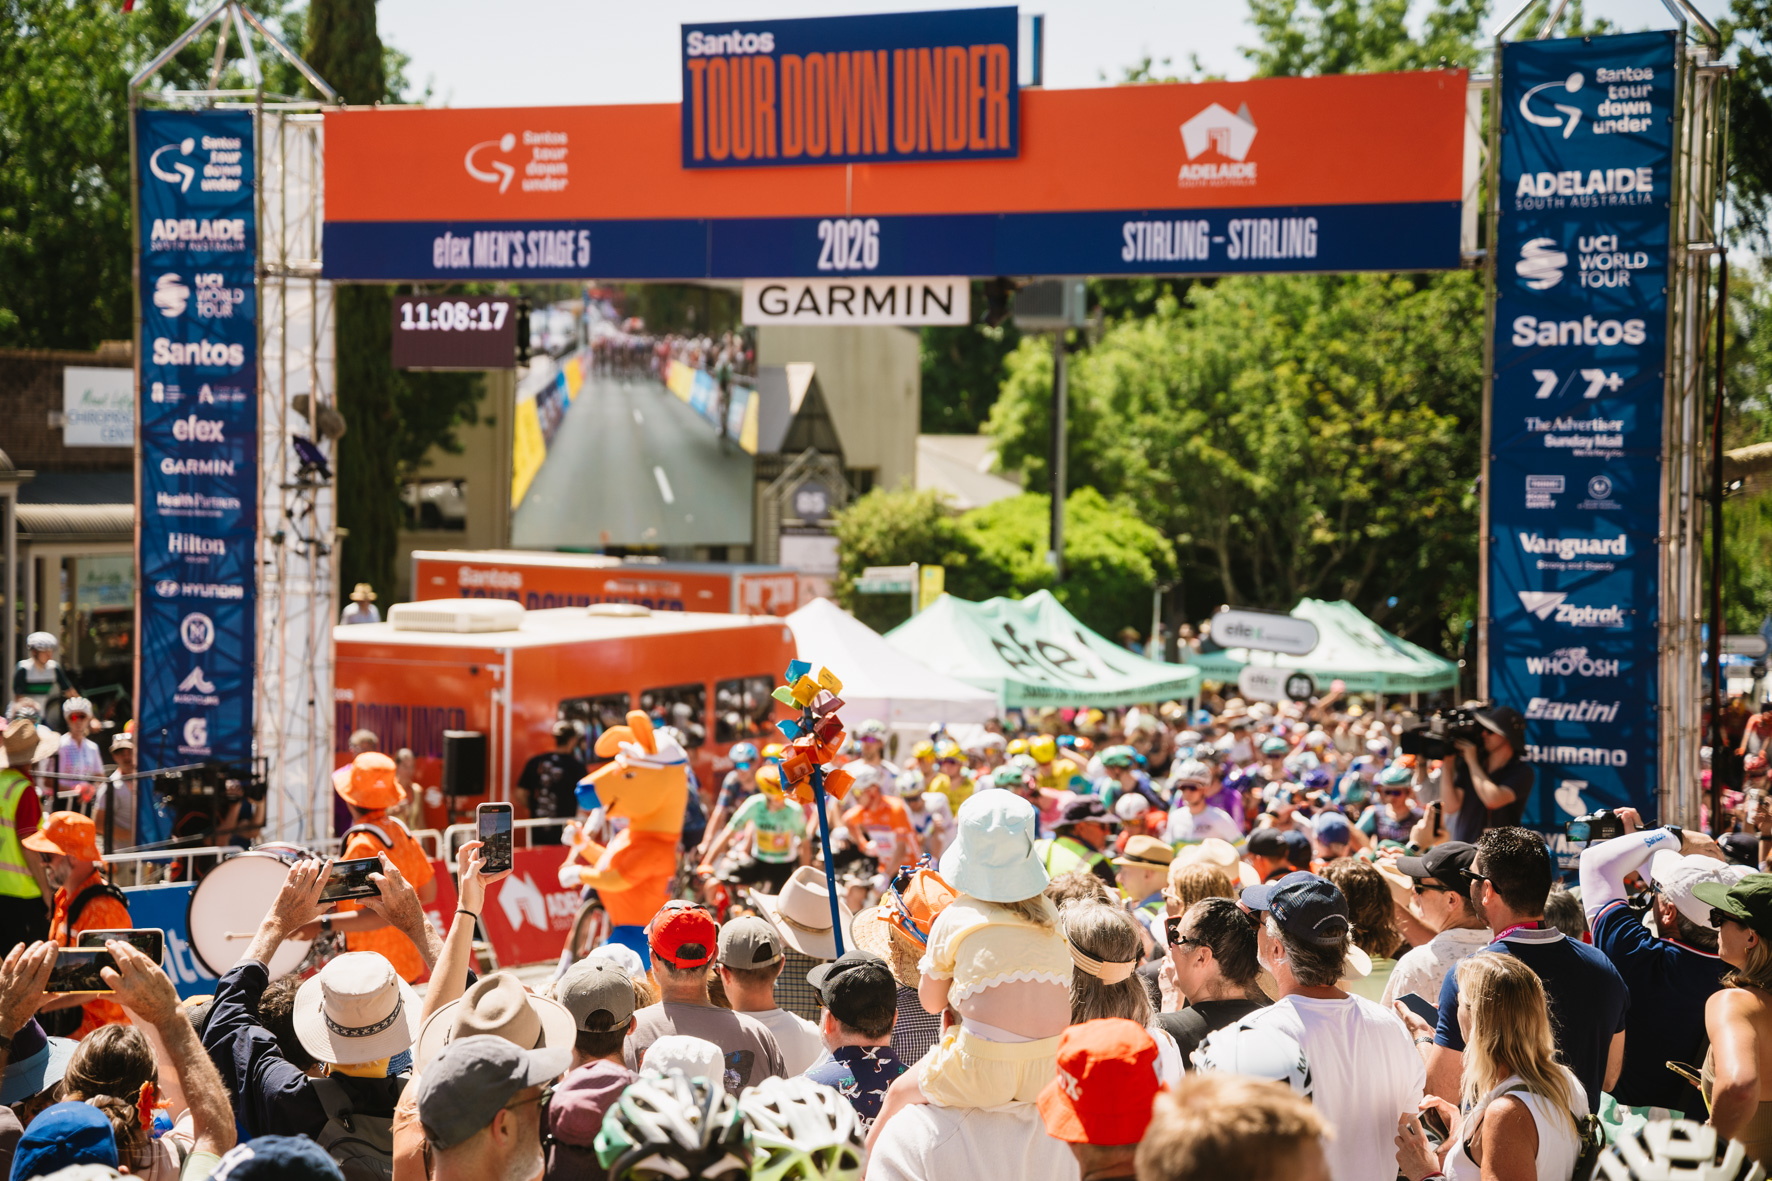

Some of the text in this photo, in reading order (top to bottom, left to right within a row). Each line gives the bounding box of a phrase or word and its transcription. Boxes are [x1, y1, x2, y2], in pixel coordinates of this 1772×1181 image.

[687, 30, 775, 57] Santos
[1596, 64, 1654, 83] Santos
[1607, 82, 1653, 99] tour
[688, 43, 1010, 160] TOUR DOWN UNDER
[1597, 97, 1652, 117] down
[1593, 115, 1653, 135] under
[201, 135, 242, 150] Santos
[1178, 162, 1258, 181] ADELAIDE
[201, 177, 242, 192] under
[521, 176, 569, 192] under
[1516, 167, 1653, 199] ADELAIDE
[1515, 191, 1653, 211] SOUTH AUSTRALIA
[150, 219, 245, 241] ADELAIDE
[1122, 219, 1210, 262] STIRLING
[1227, 216, 1318, 260] STIRLING
[433, 229, 591, 268] efex MEN'S STAGE 5
[817, 218, 880, 270] 2026
[1578, 234, 1618, 253] UCI
[1579, 251, 1649, 271] WORLD
[194, 273, 224, 289] UCI
[1579, 269, 1631, 288] TOUR
[195, 288, 245, 304] WORLD
[757, 284, 954, 317] GARMIN
[196, 303, 234, 319] TOUR
[400, 301, 509, 331] 11:08:17
[1511, 314, 1647, 347] Santos
[152, 337, 245, 366] Santos
[1531, 368, 1559, 399] 7
[172, 414, 226, 442] efex
[1524, 416, 1624, 432] The Advertiser
[1543, 433, 1624, 450] Sunday Mail
[160, 457, 236, 476] GARMIN
[168, 532, 227, 556] Hilton
[1518, 531, 1628, 560] Vanguard
[458, 565, 523, 588] Santos
[181, 582, 244, 600] HYUNDAI
[1554, 603, 1625, 627] Ziptrak
[1525, 656, 1619, 677] WHOOSH
[1524, 697, 1621, 723] Santini
[1521, 745, 1628, 767] SHIMANO
